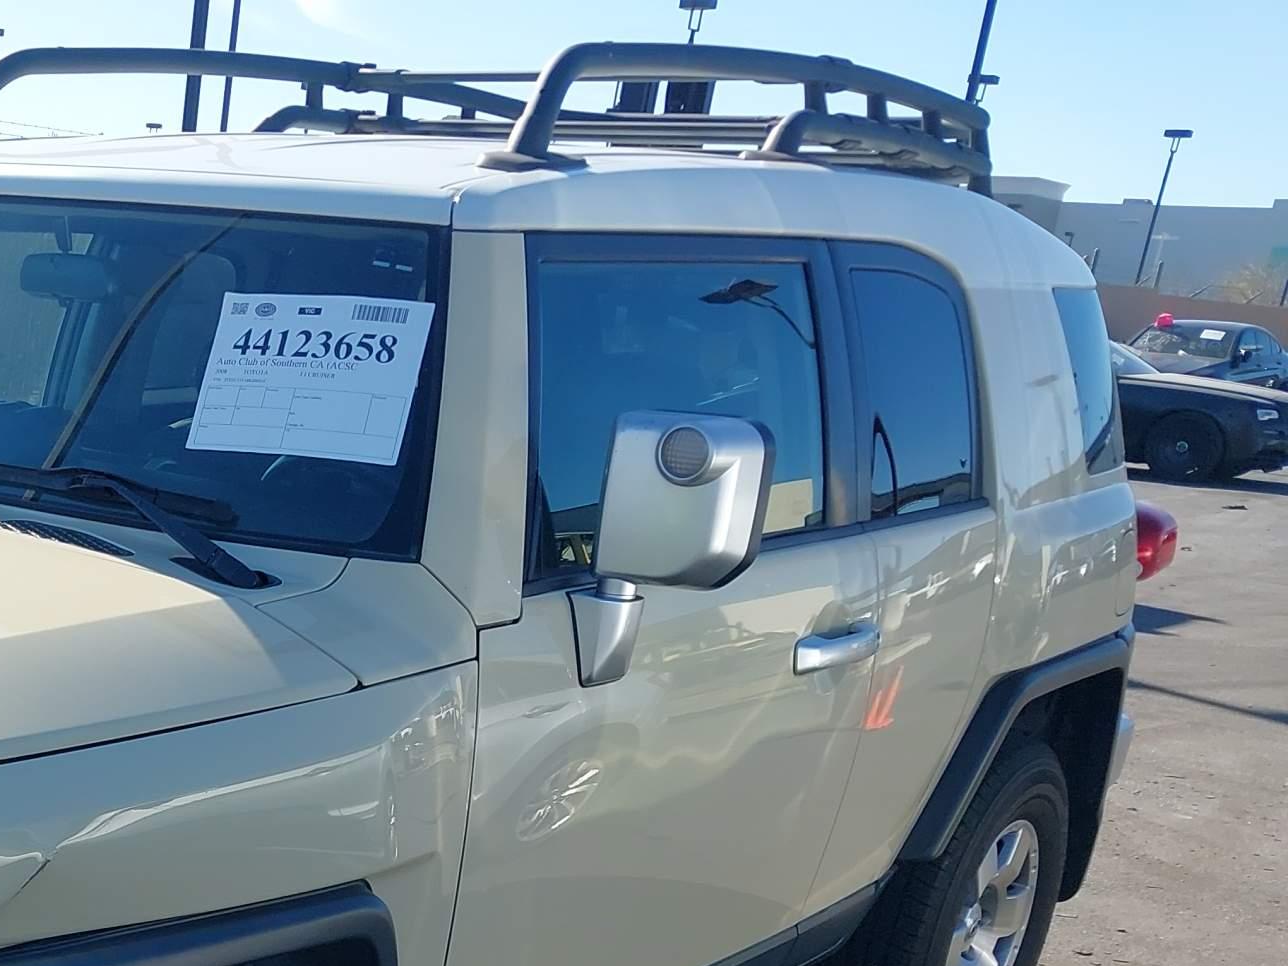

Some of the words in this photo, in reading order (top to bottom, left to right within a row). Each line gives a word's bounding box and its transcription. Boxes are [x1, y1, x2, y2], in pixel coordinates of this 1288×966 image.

[232, 327, 398, 364] 44123658
[216, 357, 237, 366] Auto
[238, 357, 258, 366] Club
[259, 358, 271, 367] of
[271, 358, 307, 368] Southern
[310, 360, 324, 369] CA
